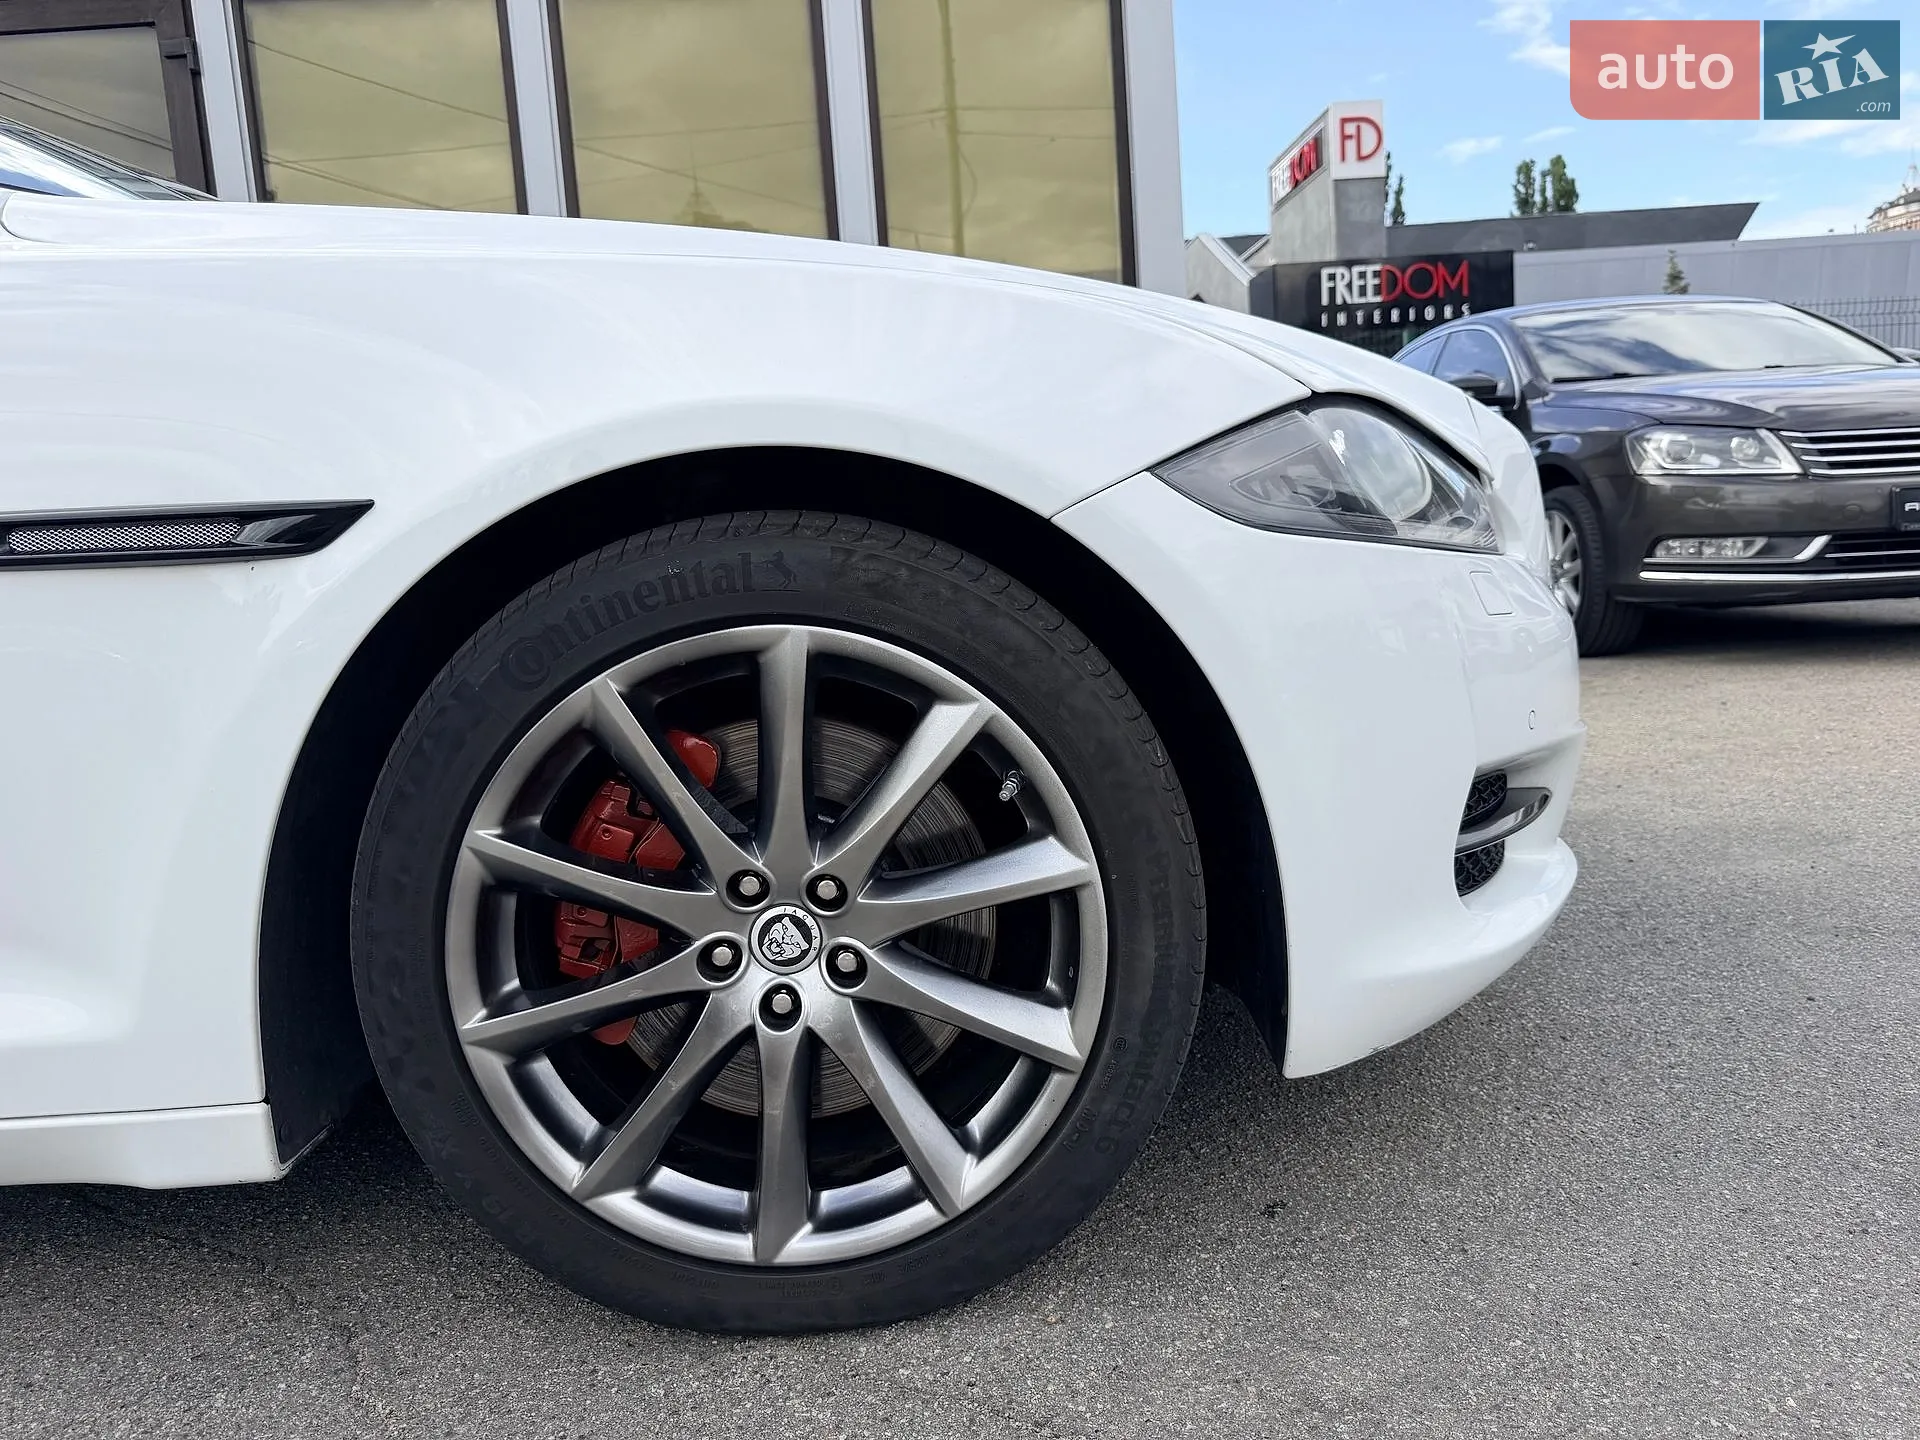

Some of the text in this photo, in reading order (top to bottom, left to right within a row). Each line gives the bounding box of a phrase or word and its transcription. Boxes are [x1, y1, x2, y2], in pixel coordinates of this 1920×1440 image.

[1340, 117, 1382, 162] FD
[1321, 260, 1470, 306] FREEDOM
[1321, 303, 1471, 327] INTERIORS
[501, 552, 756, 691] Continental
[783, 907, 819, 952] JAGUAR
